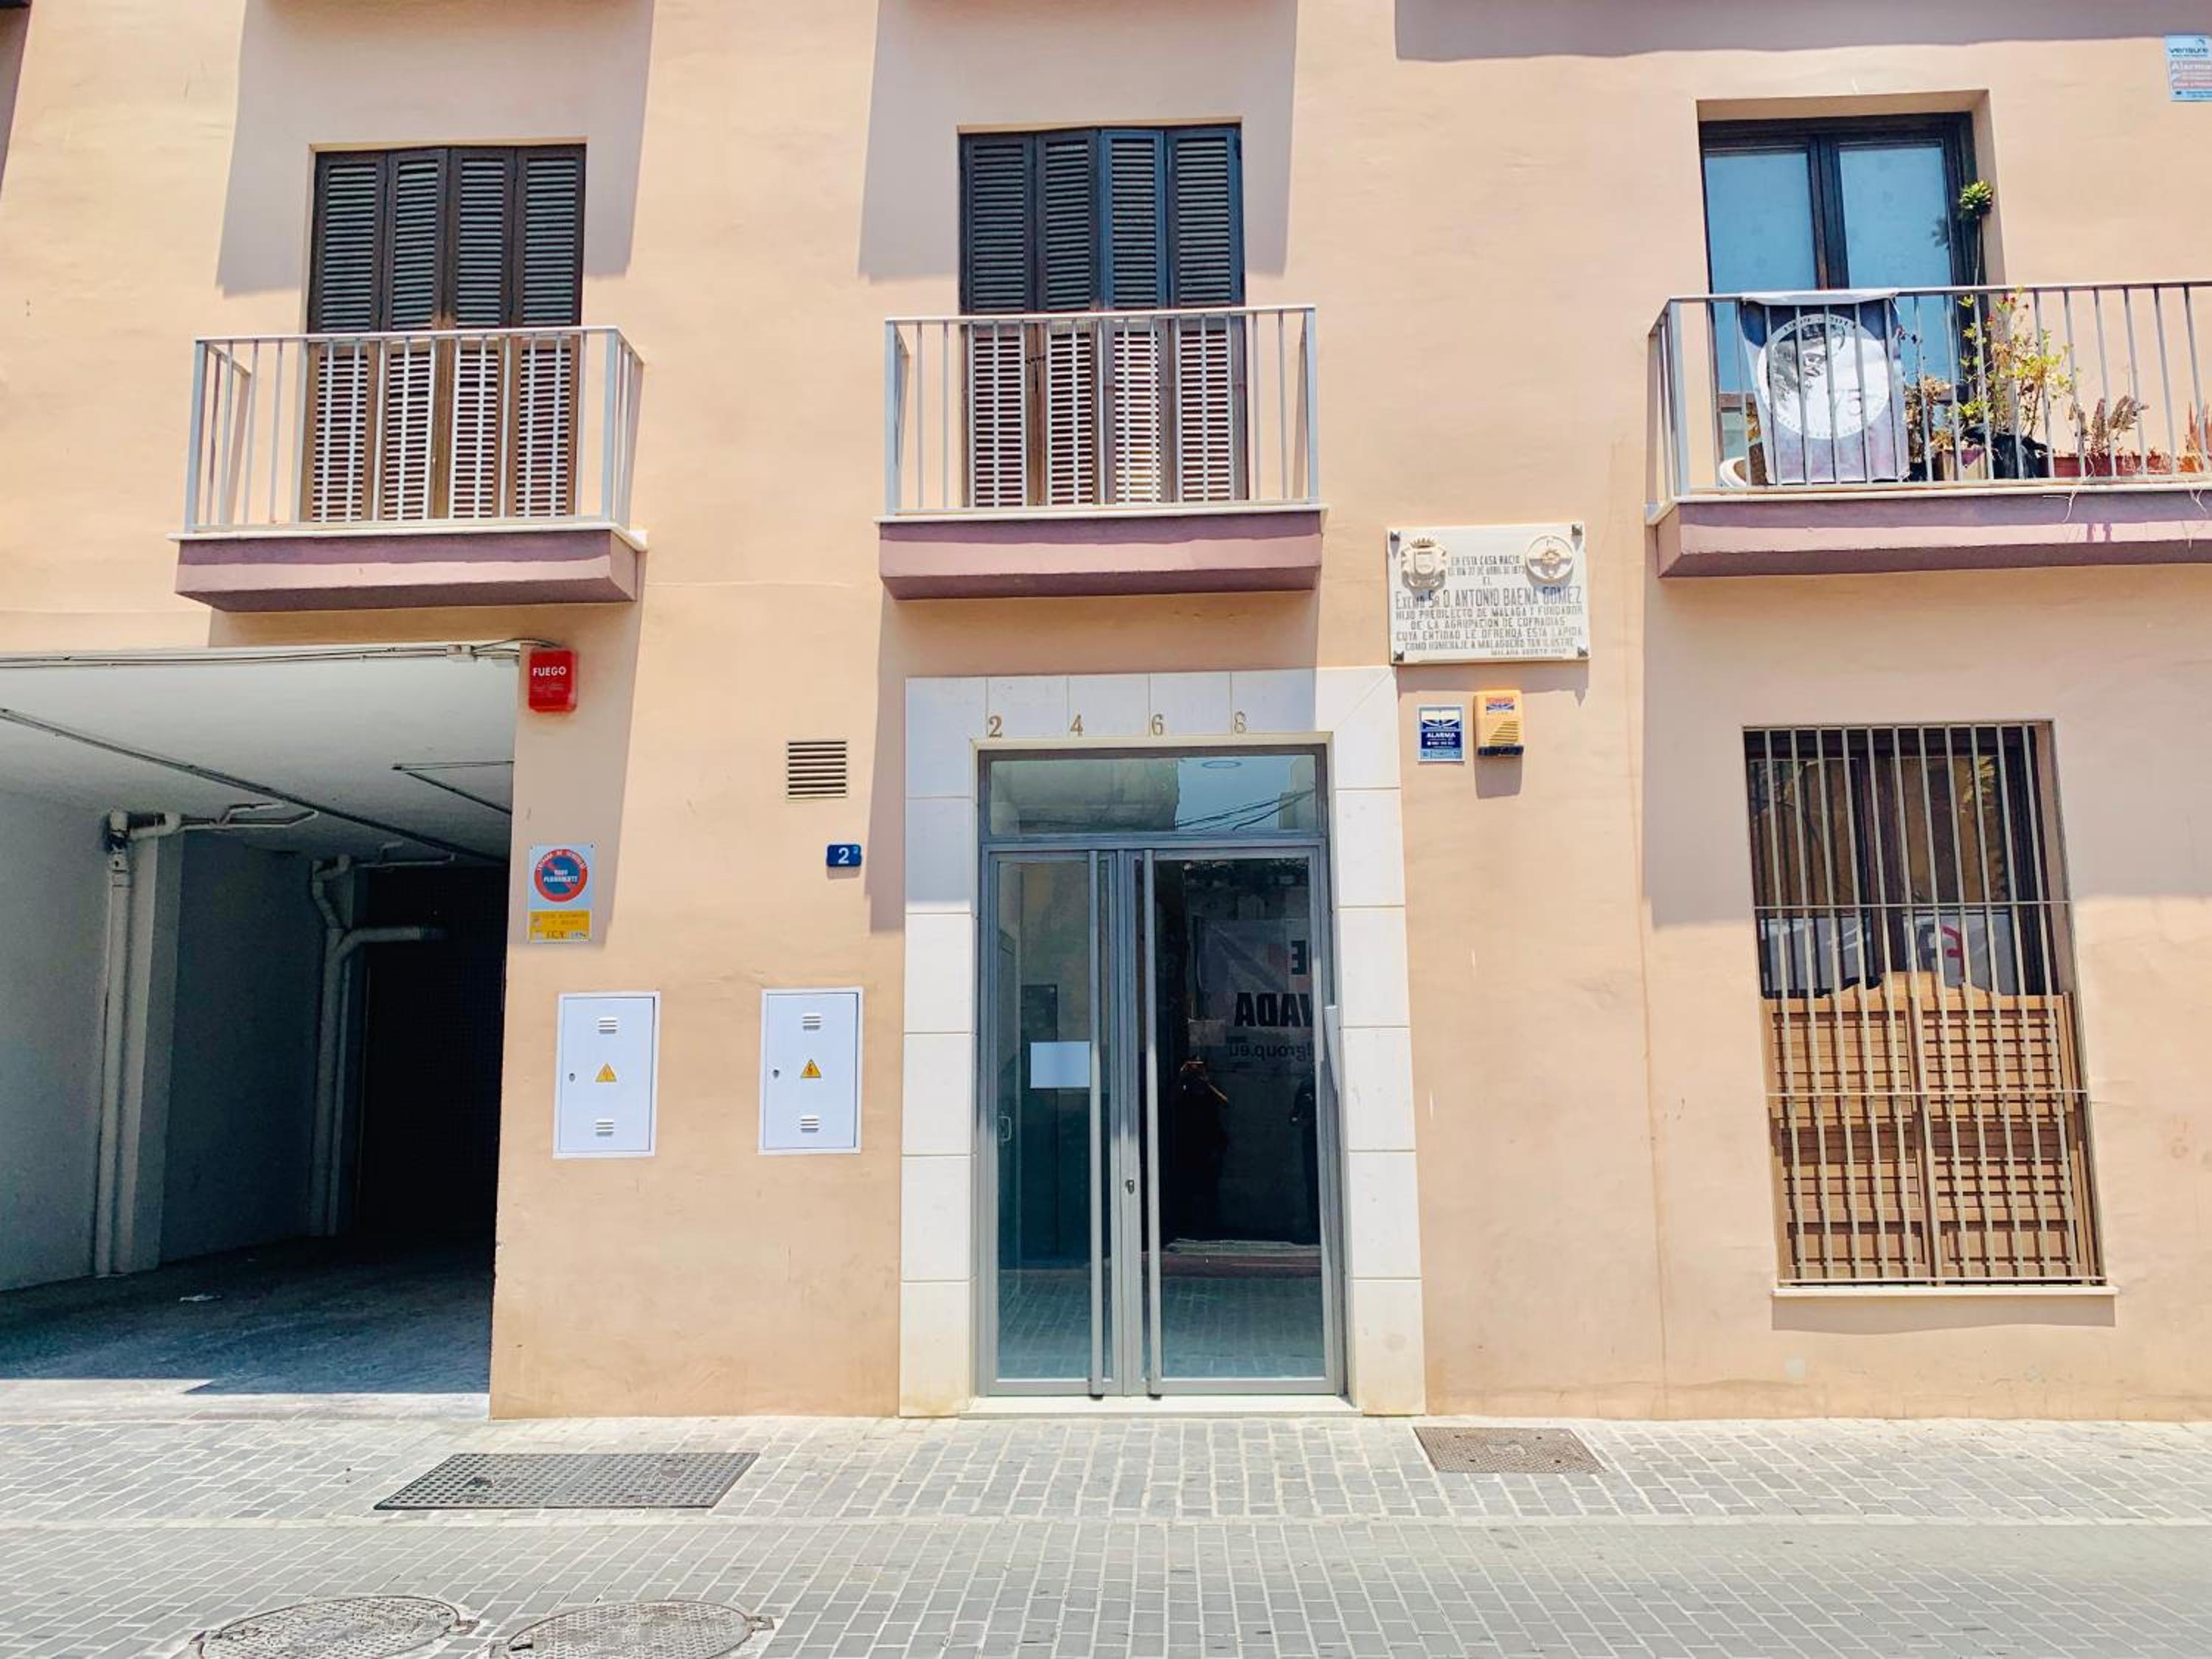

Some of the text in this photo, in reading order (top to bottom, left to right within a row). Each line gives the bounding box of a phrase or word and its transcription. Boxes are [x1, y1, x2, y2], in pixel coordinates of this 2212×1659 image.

[1480, 555, 1497, 566] CASA
[1455, 588, 1499, 607] ANTONIO
[1503, 587, 1538, 605] BAENA
[1396, 610, 1416, 620] HIJO
[1419, 608, 1473, 619] PREDILECTO
[1411, 620, 1422, 630] DE
[1427, 619, 1439, 630] LA
[1444, 617, 1499, 630] AGRUPACION
[1502, 617, 1513, 627] DE
[1396, 631, 1417, 641] CUYA
[1422, 630, 1461, 641] ENTIDAD
[1465, 629, 1477, 639] LE
[1481, 628, 1522, 639] OFRENDA
[1526, 627, 1547, 637] ESTA
[532, 666, 567, 677] FUEGO
[988, 711, 1247, 738] 2 4 6 8
[838, 846, 849, 865] 2
